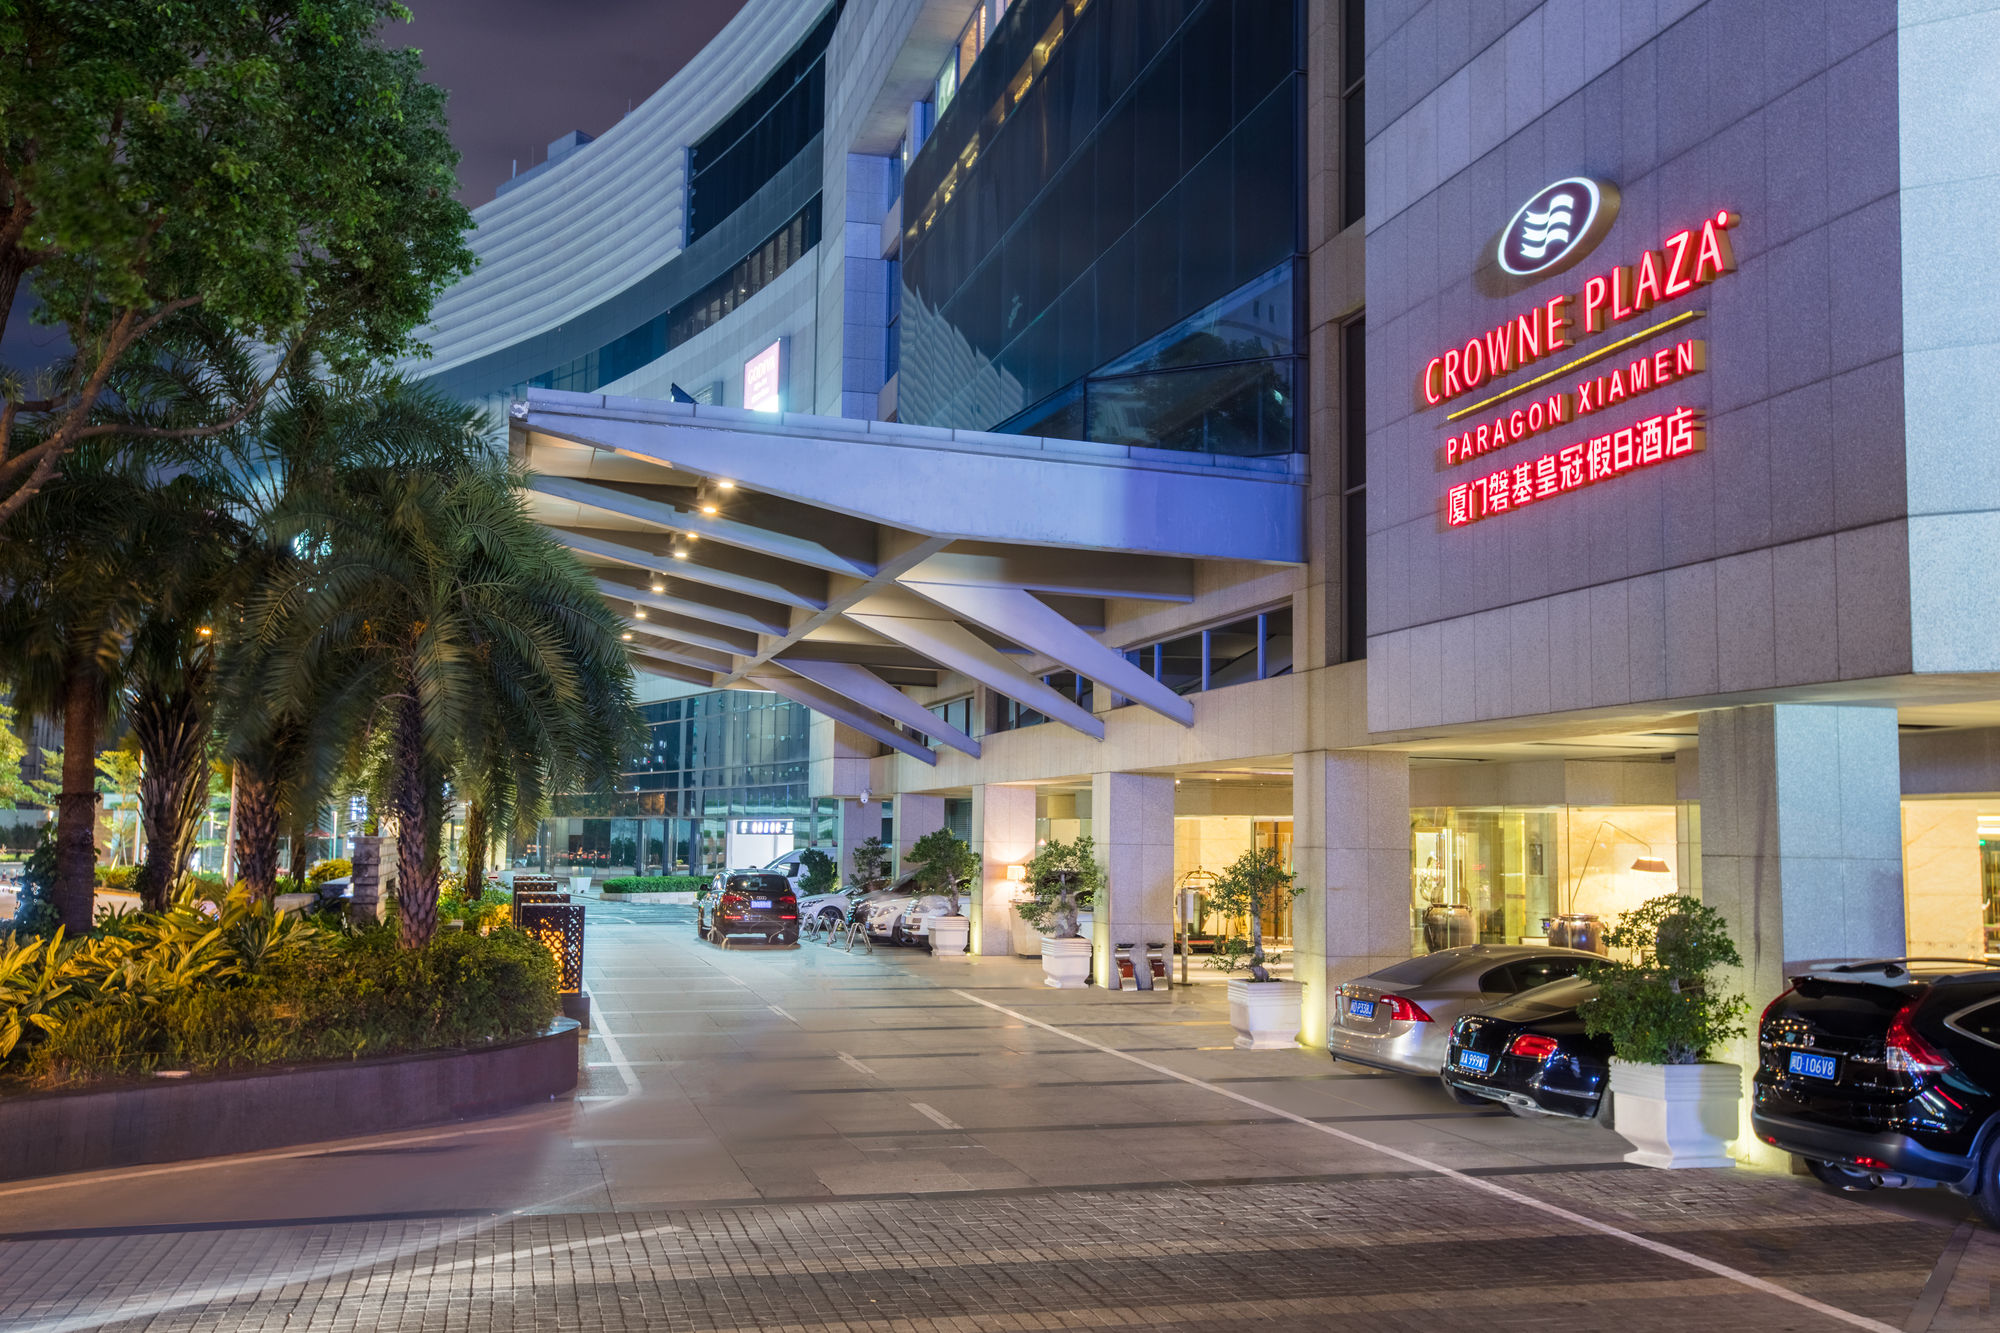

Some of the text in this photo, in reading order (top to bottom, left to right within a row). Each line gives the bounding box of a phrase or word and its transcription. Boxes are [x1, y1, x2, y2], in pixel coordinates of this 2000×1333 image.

[1424, 218, 1724, 405] CROWNE PLAZA
[1447, 339, 1694, 465] PARAGON XIAMEN
[1447, 406, 1694, 526] 厦门磐基皇冠假日酒店
